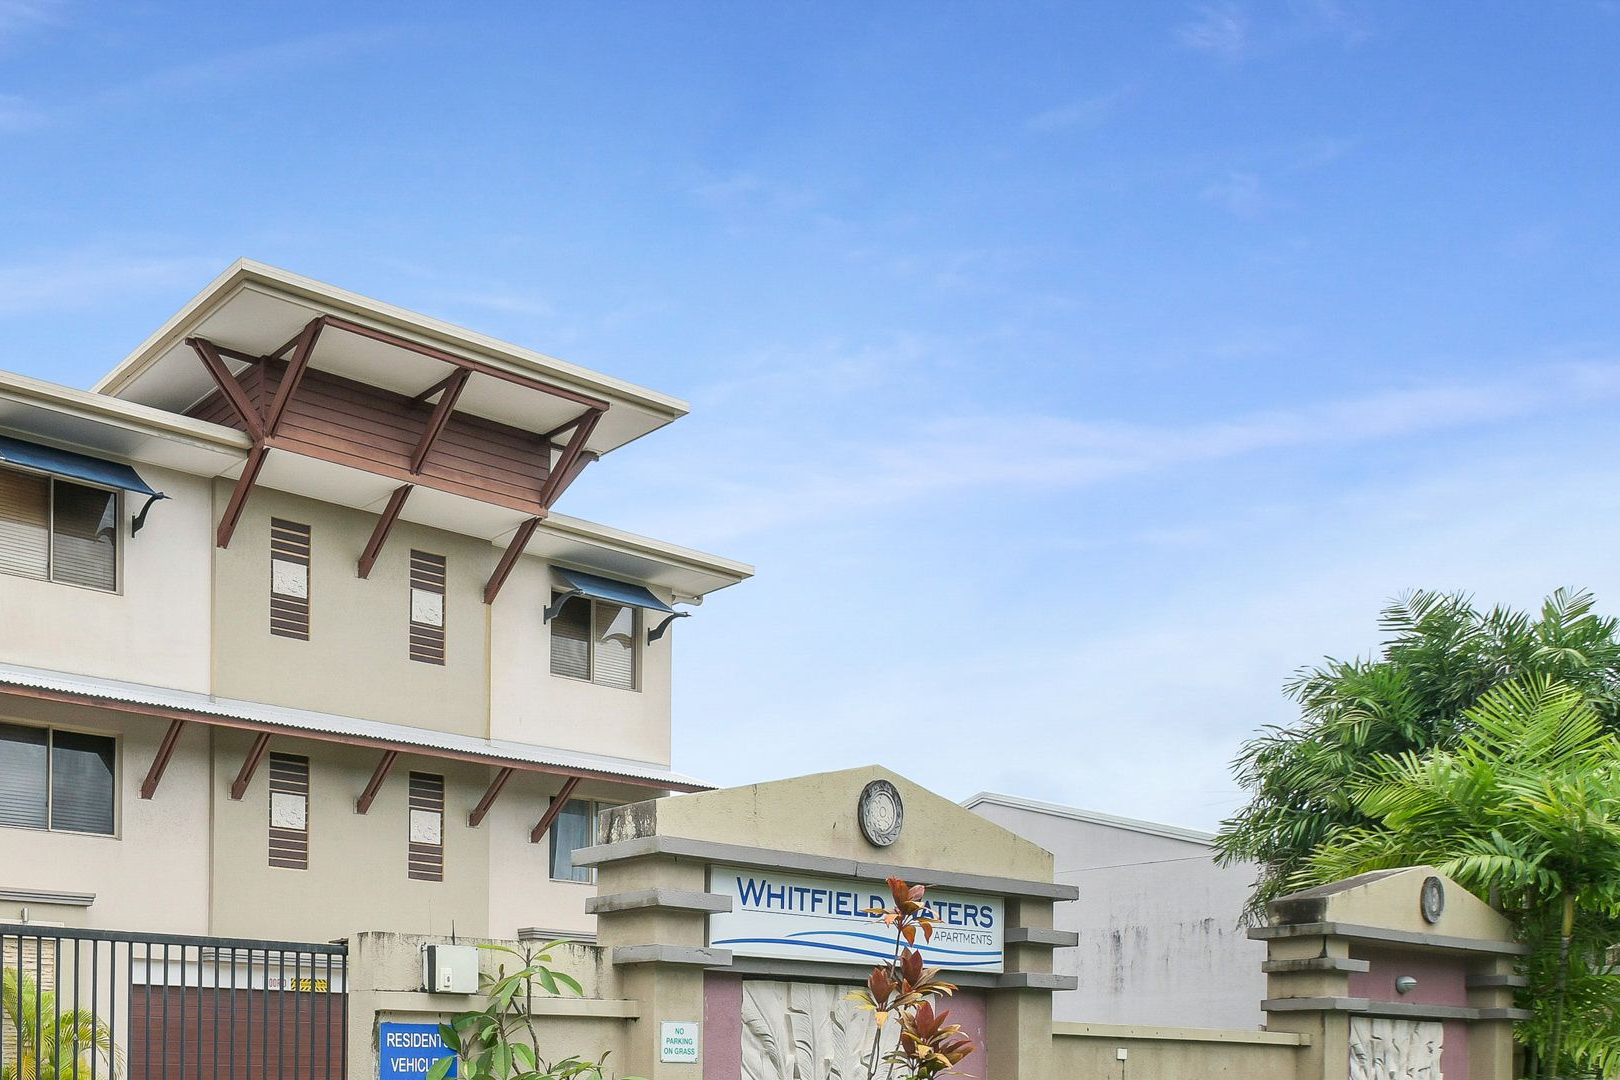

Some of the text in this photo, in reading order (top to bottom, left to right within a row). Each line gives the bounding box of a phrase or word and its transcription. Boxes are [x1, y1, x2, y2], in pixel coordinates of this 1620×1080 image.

[737, 877, 994, 928] WHITFIELD ATERS
[933, 931, 993, 946] APARTMENTS
[674, 1027, 685, 1035] NO
[386, 1032, 449, 1048] RESIDENT
[666, 1037, 693, 1045] PARKING
[663, 1047, 695, 1056] ON GRASS
